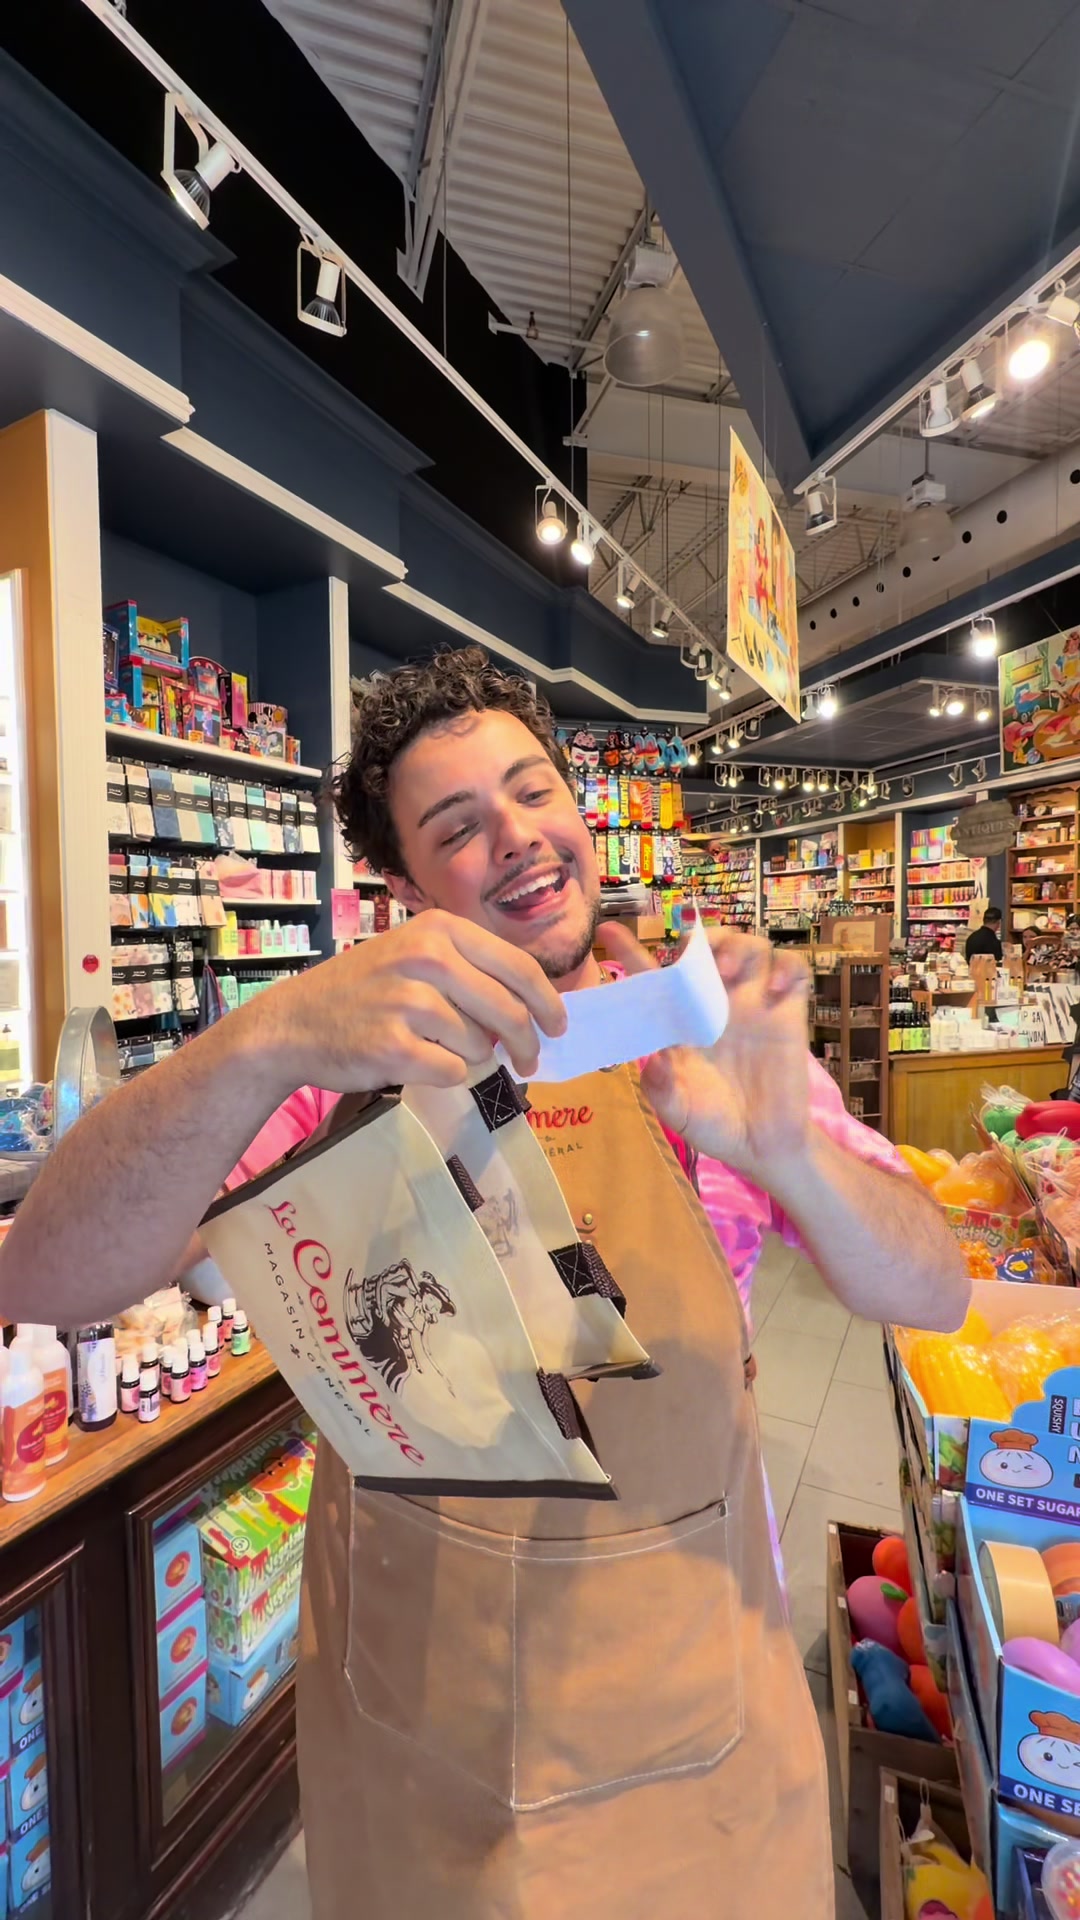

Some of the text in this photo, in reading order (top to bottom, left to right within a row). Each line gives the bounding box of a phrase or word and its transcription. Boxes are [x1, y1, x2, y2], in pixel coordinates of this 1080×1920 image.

[526, 1105, 594, 1129] mère
[264, 1243, 305, 1340] MAGASIN
[264, 1200, 425, 1467] La Commère
[1051, 1398, 1064, 1433] SQUISHY
[976, 1488, 1005, 1503] ONE
[1007, 1494, 1034, 1508] SET
[20, 1725, 42, 1750] ONE
[1013, 1784, 1080, 1817] ONE SE
[20, 1812, 42, 1835] ONE
